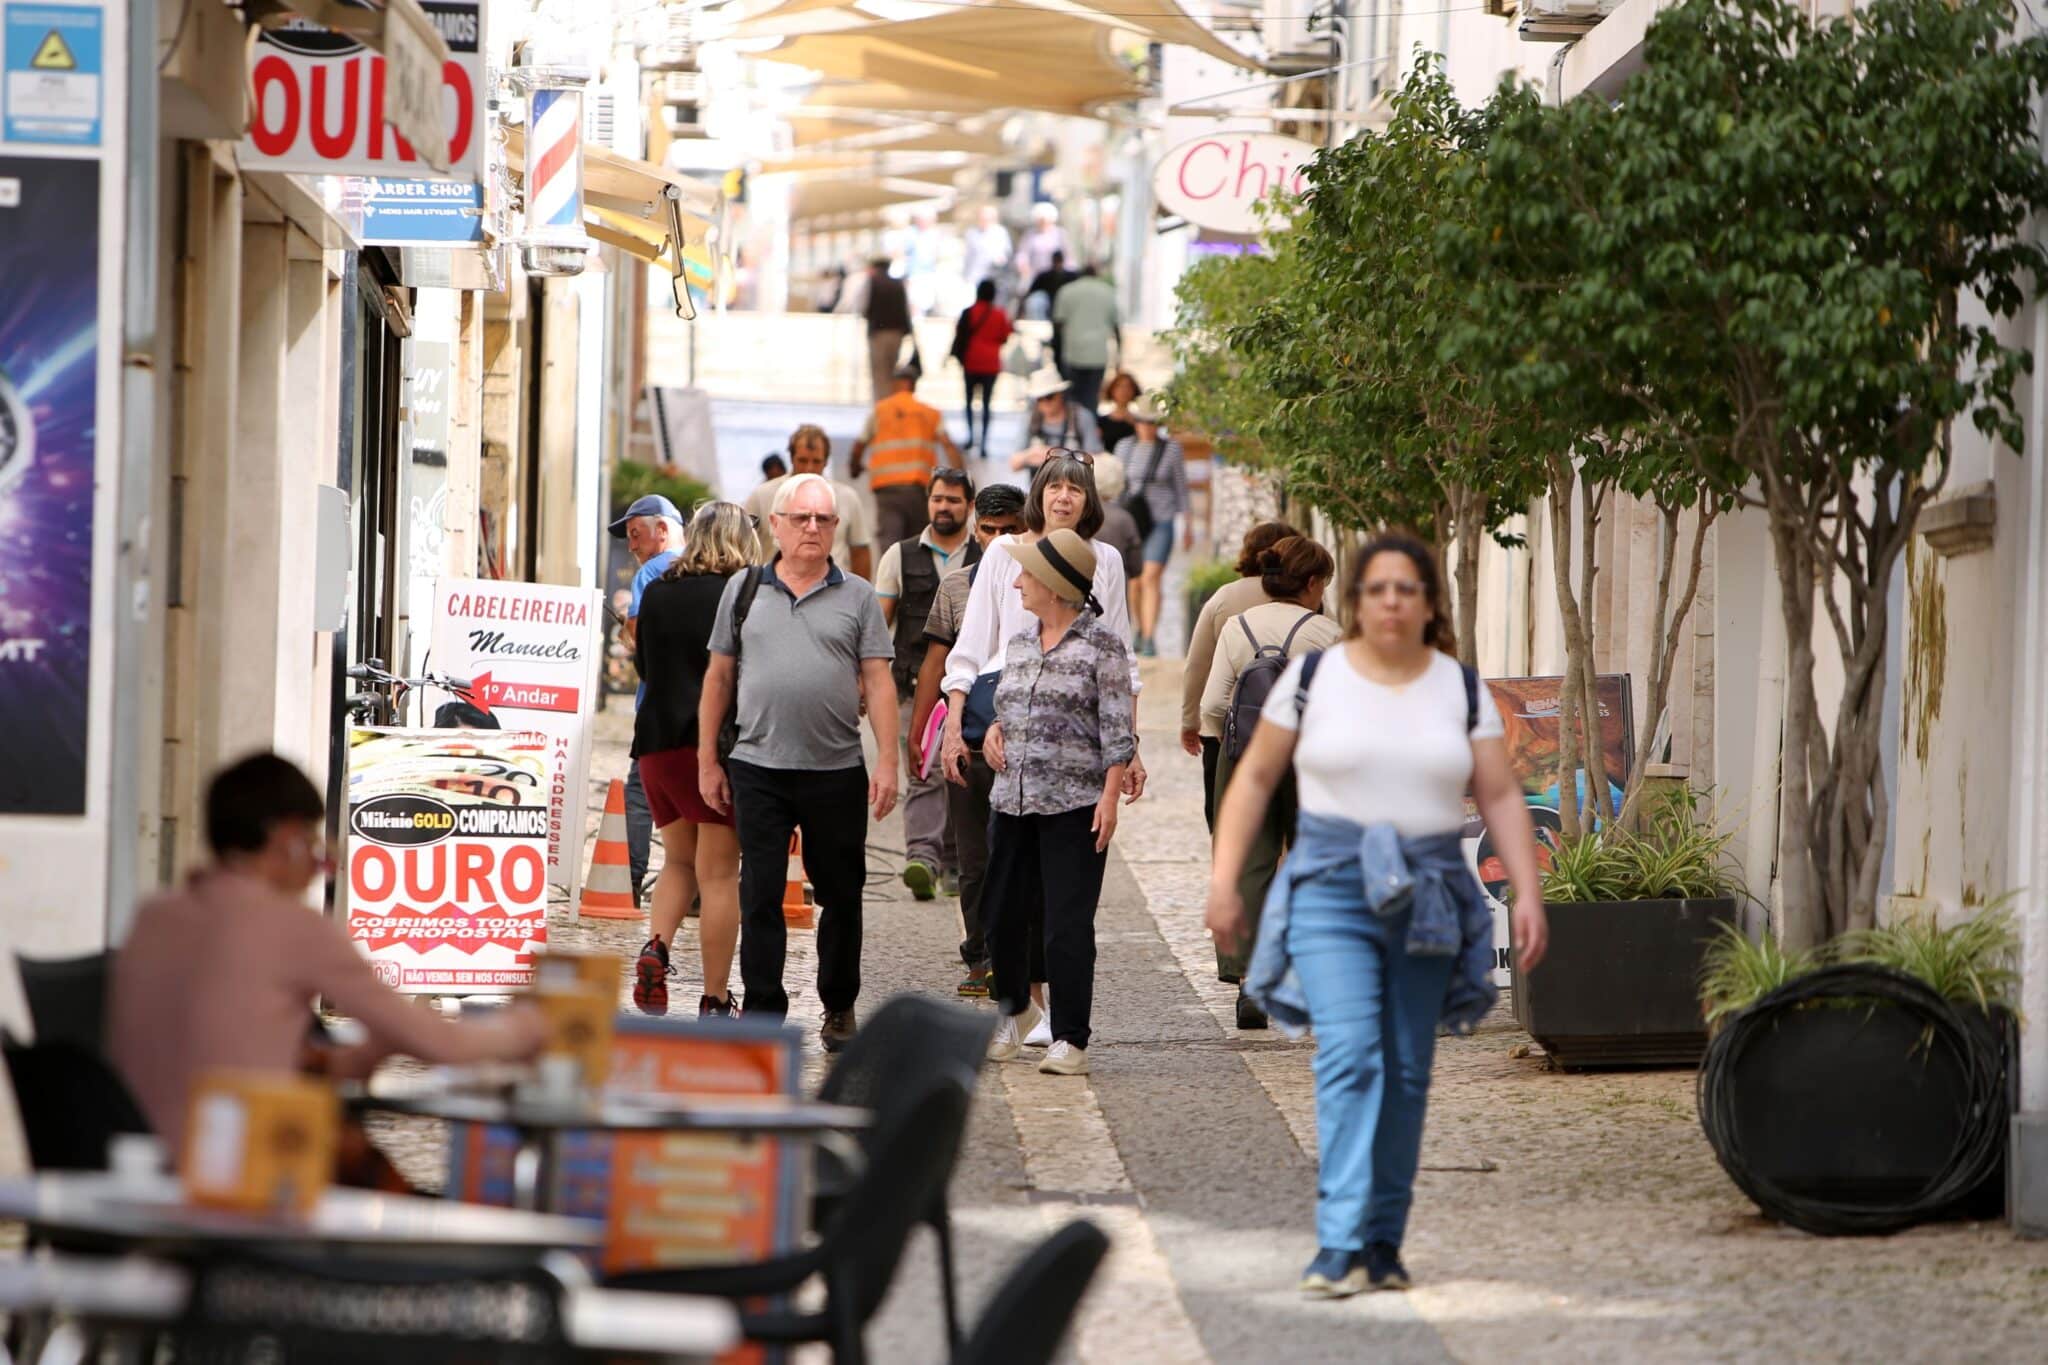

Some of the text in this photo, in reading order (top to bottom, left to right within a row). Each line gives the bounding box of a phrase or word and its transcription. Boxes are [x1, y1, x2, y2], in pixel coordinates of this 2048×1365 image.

[364, 184, 472, 197] BARBER SHOP
[447, 592, 587, 627] CABELEIREIRA
[468, 629, 580, 660] Manuela
[502, 687, 559, 705] Andar
[547, 737, 568, 866] HAIRDRESSER
[459, 809, 547, 834] COMPRAMOS
[351, 843, 545, 904] OURO
[351, 917, 547, 929] COBRIMOS TODAS
[352, 927, 535, 939] AS PROPOSTAS
